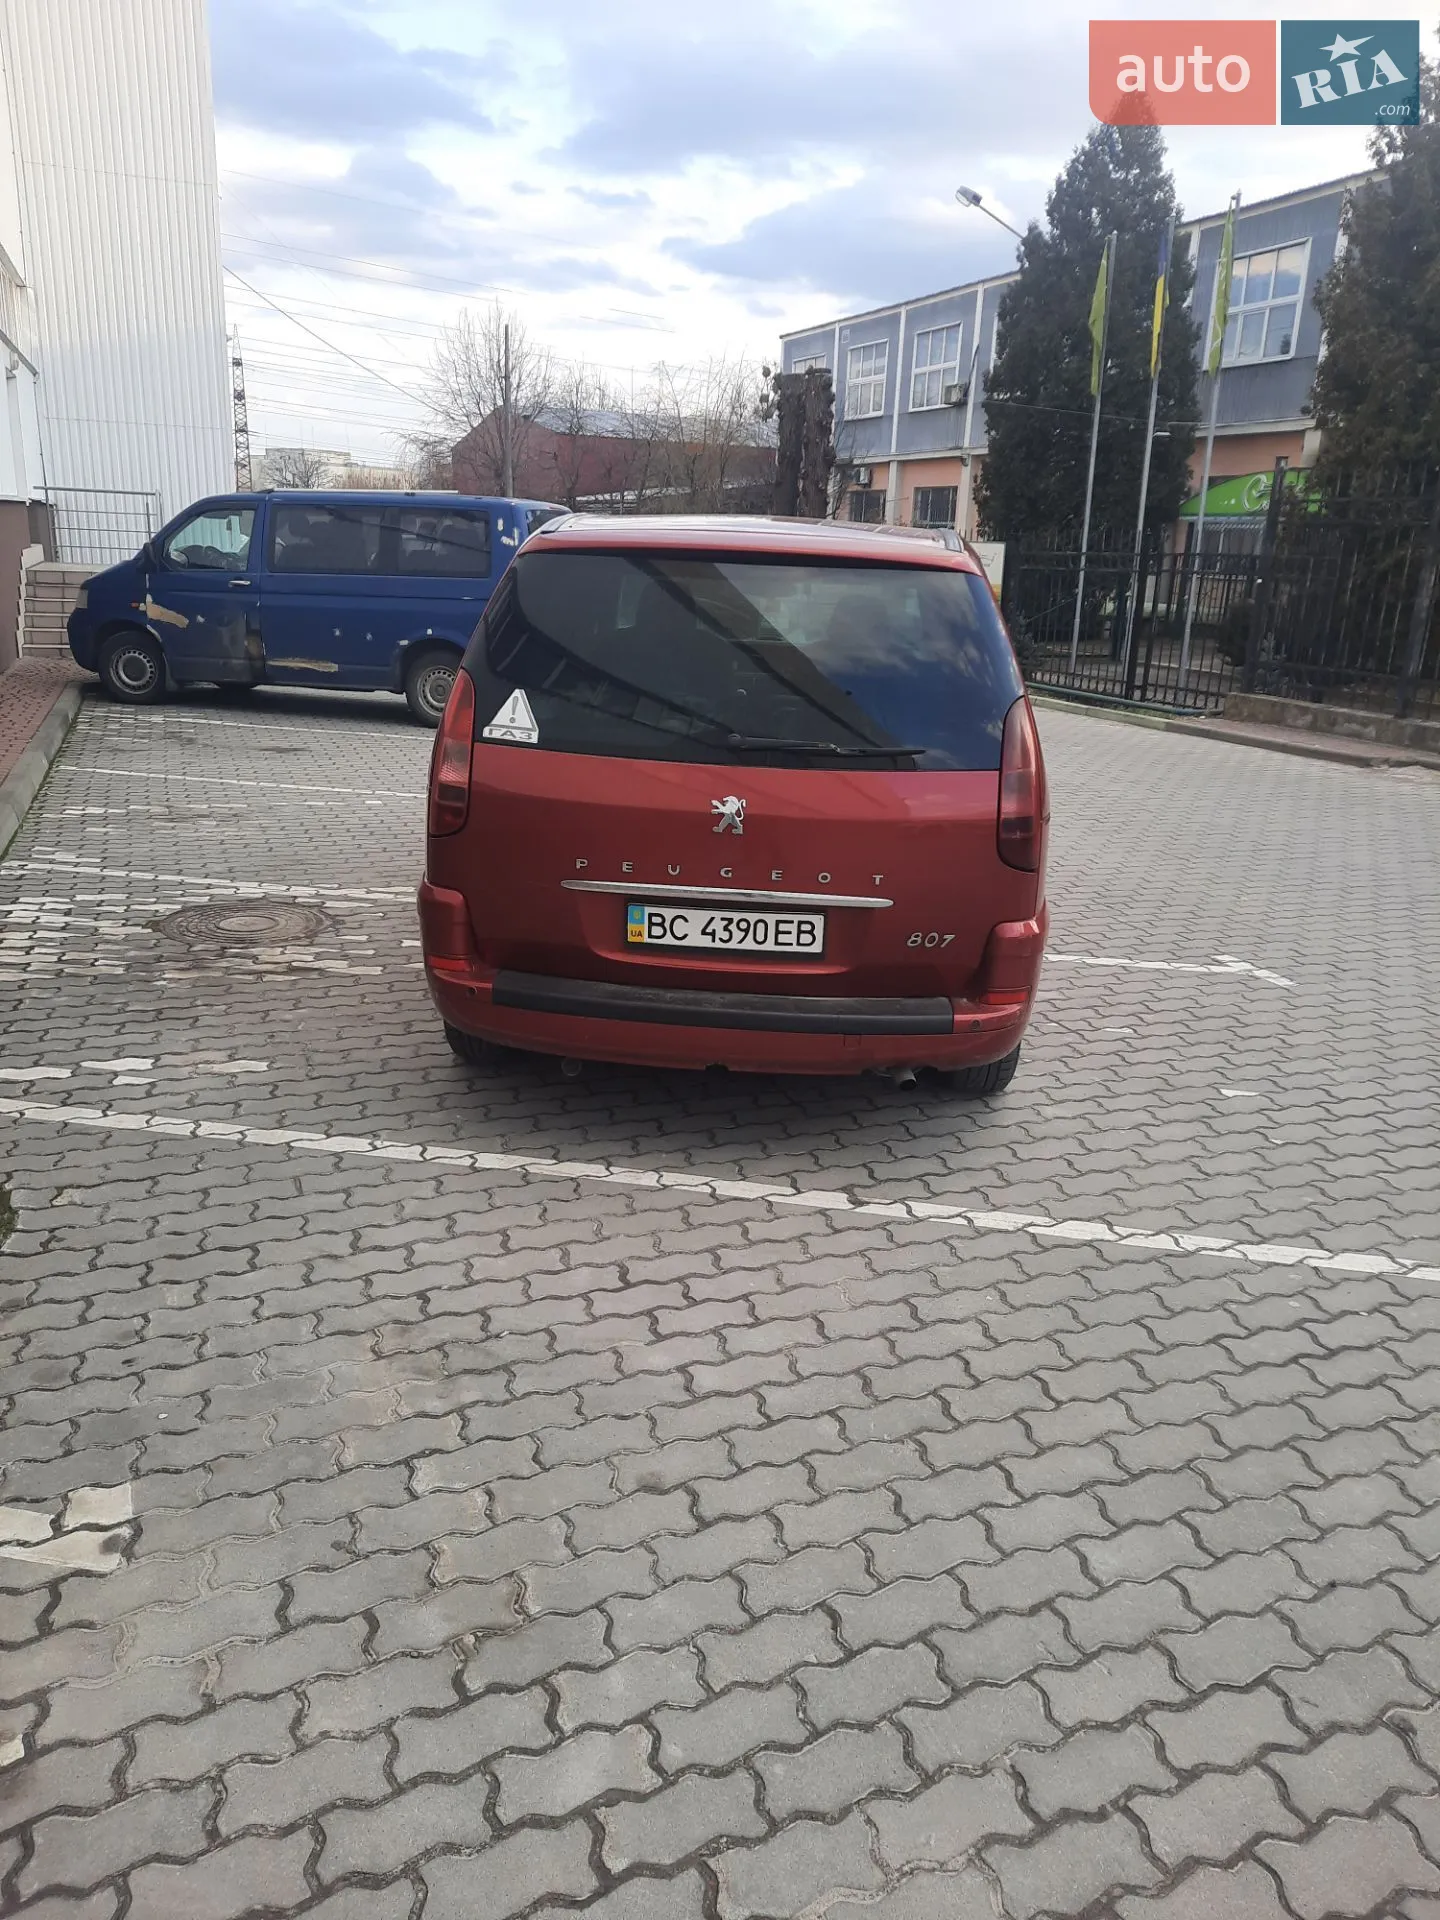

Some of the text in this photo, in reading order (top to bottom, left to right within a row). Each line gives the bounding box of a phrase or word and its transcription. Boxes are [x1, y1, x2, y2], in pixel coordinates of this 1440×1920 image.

[488, 728, 532, 740] ГАЗ
[575, 858, 884, 886] PEUGEOT
[630, 930, 643, 938] UA
[646, 912, 689, 941] BC
[907, 932, 956, 948] 807
